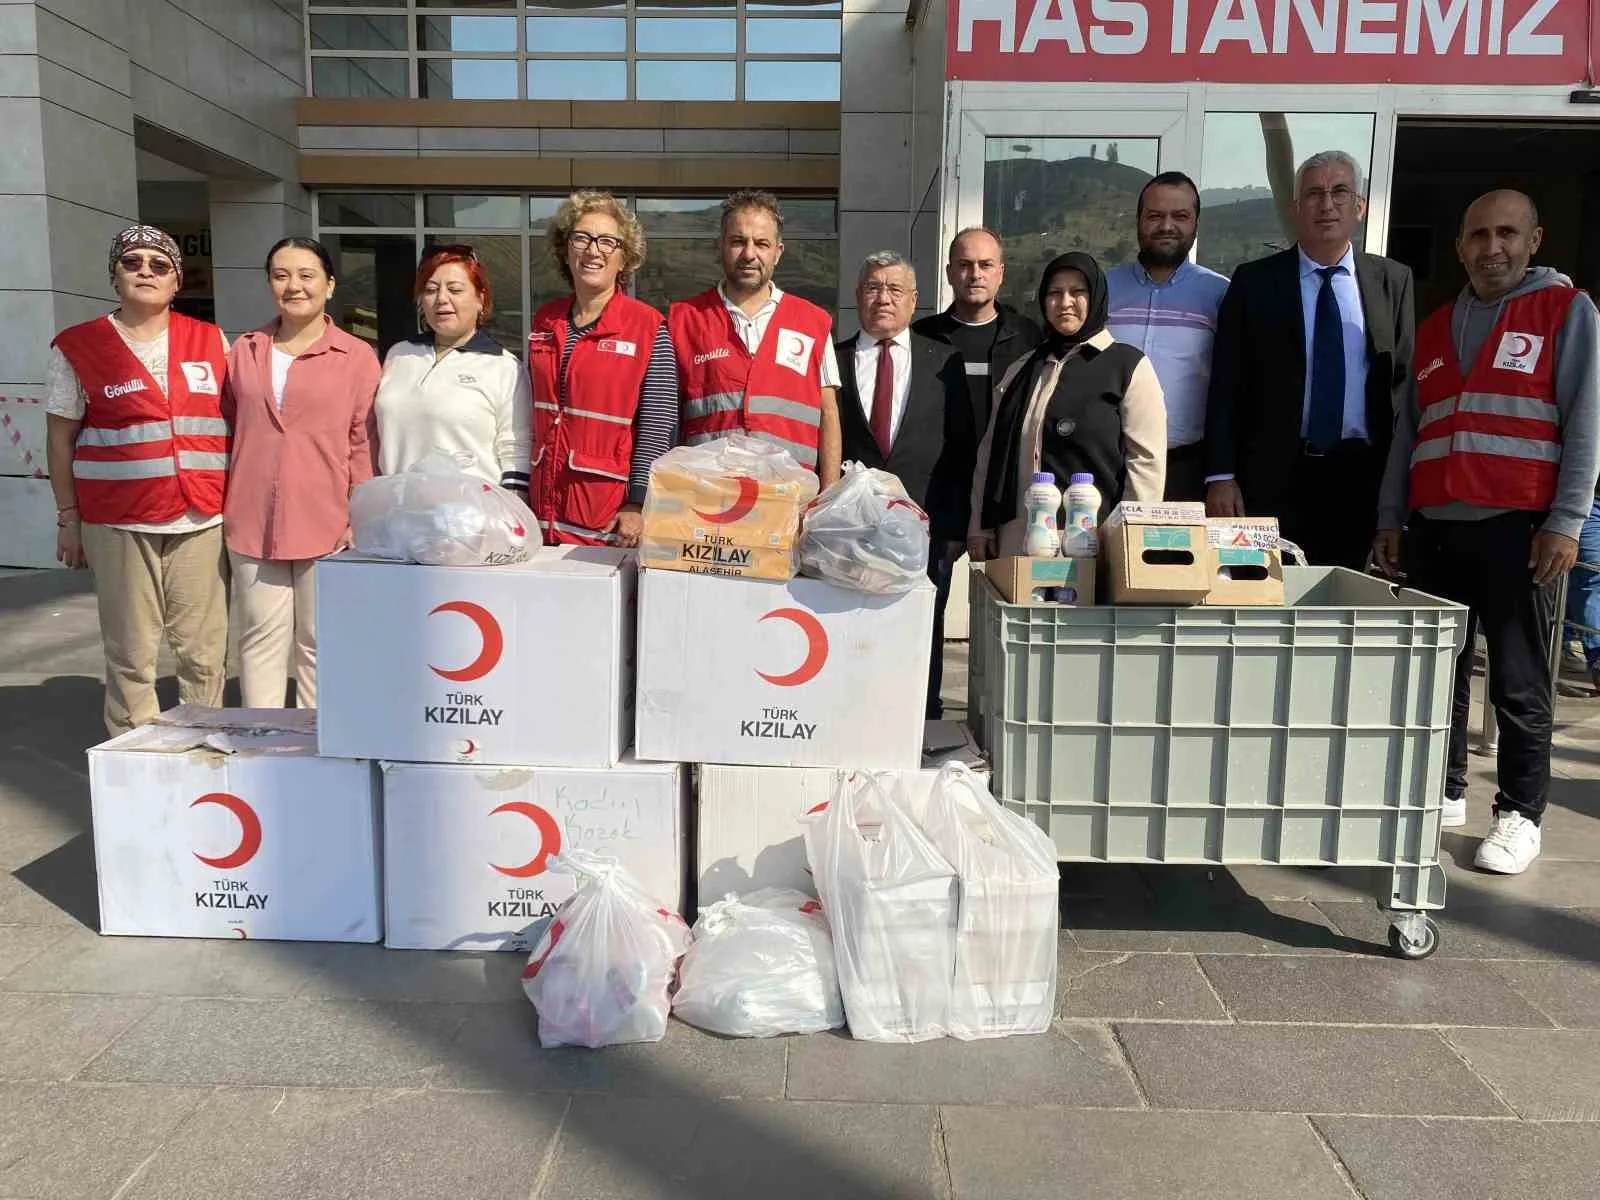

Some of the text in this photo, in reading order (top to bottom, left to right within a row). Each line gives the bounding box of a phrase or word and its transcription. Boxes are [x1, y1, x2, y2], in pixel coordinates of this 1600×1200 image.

[682, 543, 752, 563] KIZILAY
[446, 691, 483, 706] TÜRK
[425, 706, 504, 726] KIZILAY
[762, 706, 798, 721] TÜRK
[740, 720, 817, 740] KIZILAY
[214, 878, 249, 891] TÜRK
[195, 892, 269, 910] KIZILAY
[507, 887, 544, 901] TÜRK
[487, 901, 563, 918] KIZILAY
